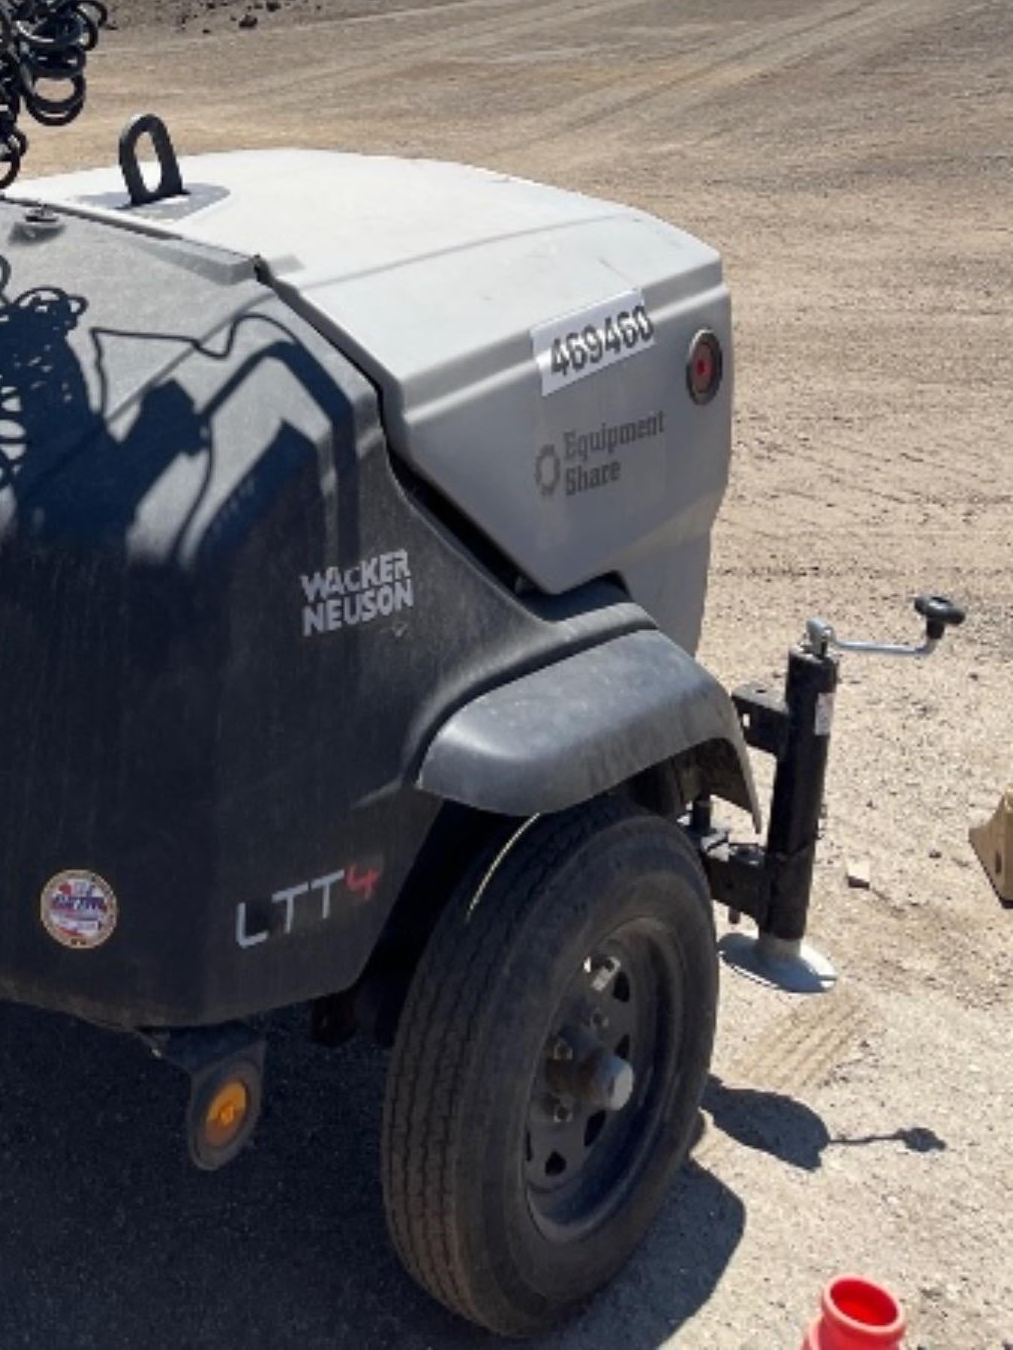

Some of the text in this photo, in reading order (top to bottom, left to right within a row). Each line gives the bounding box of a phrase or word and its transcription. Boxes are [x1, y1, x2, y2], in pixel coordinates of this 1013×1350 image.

[551, 305, 654, 376] 469460
[563, 410, 666, 462] Equipment
[564, 460, 622, 497] Share
[299, 548, 411, 603] WACKER
[302, 578, 414, 637] NEUSON
[234, 863, 382, 949] LTT4
